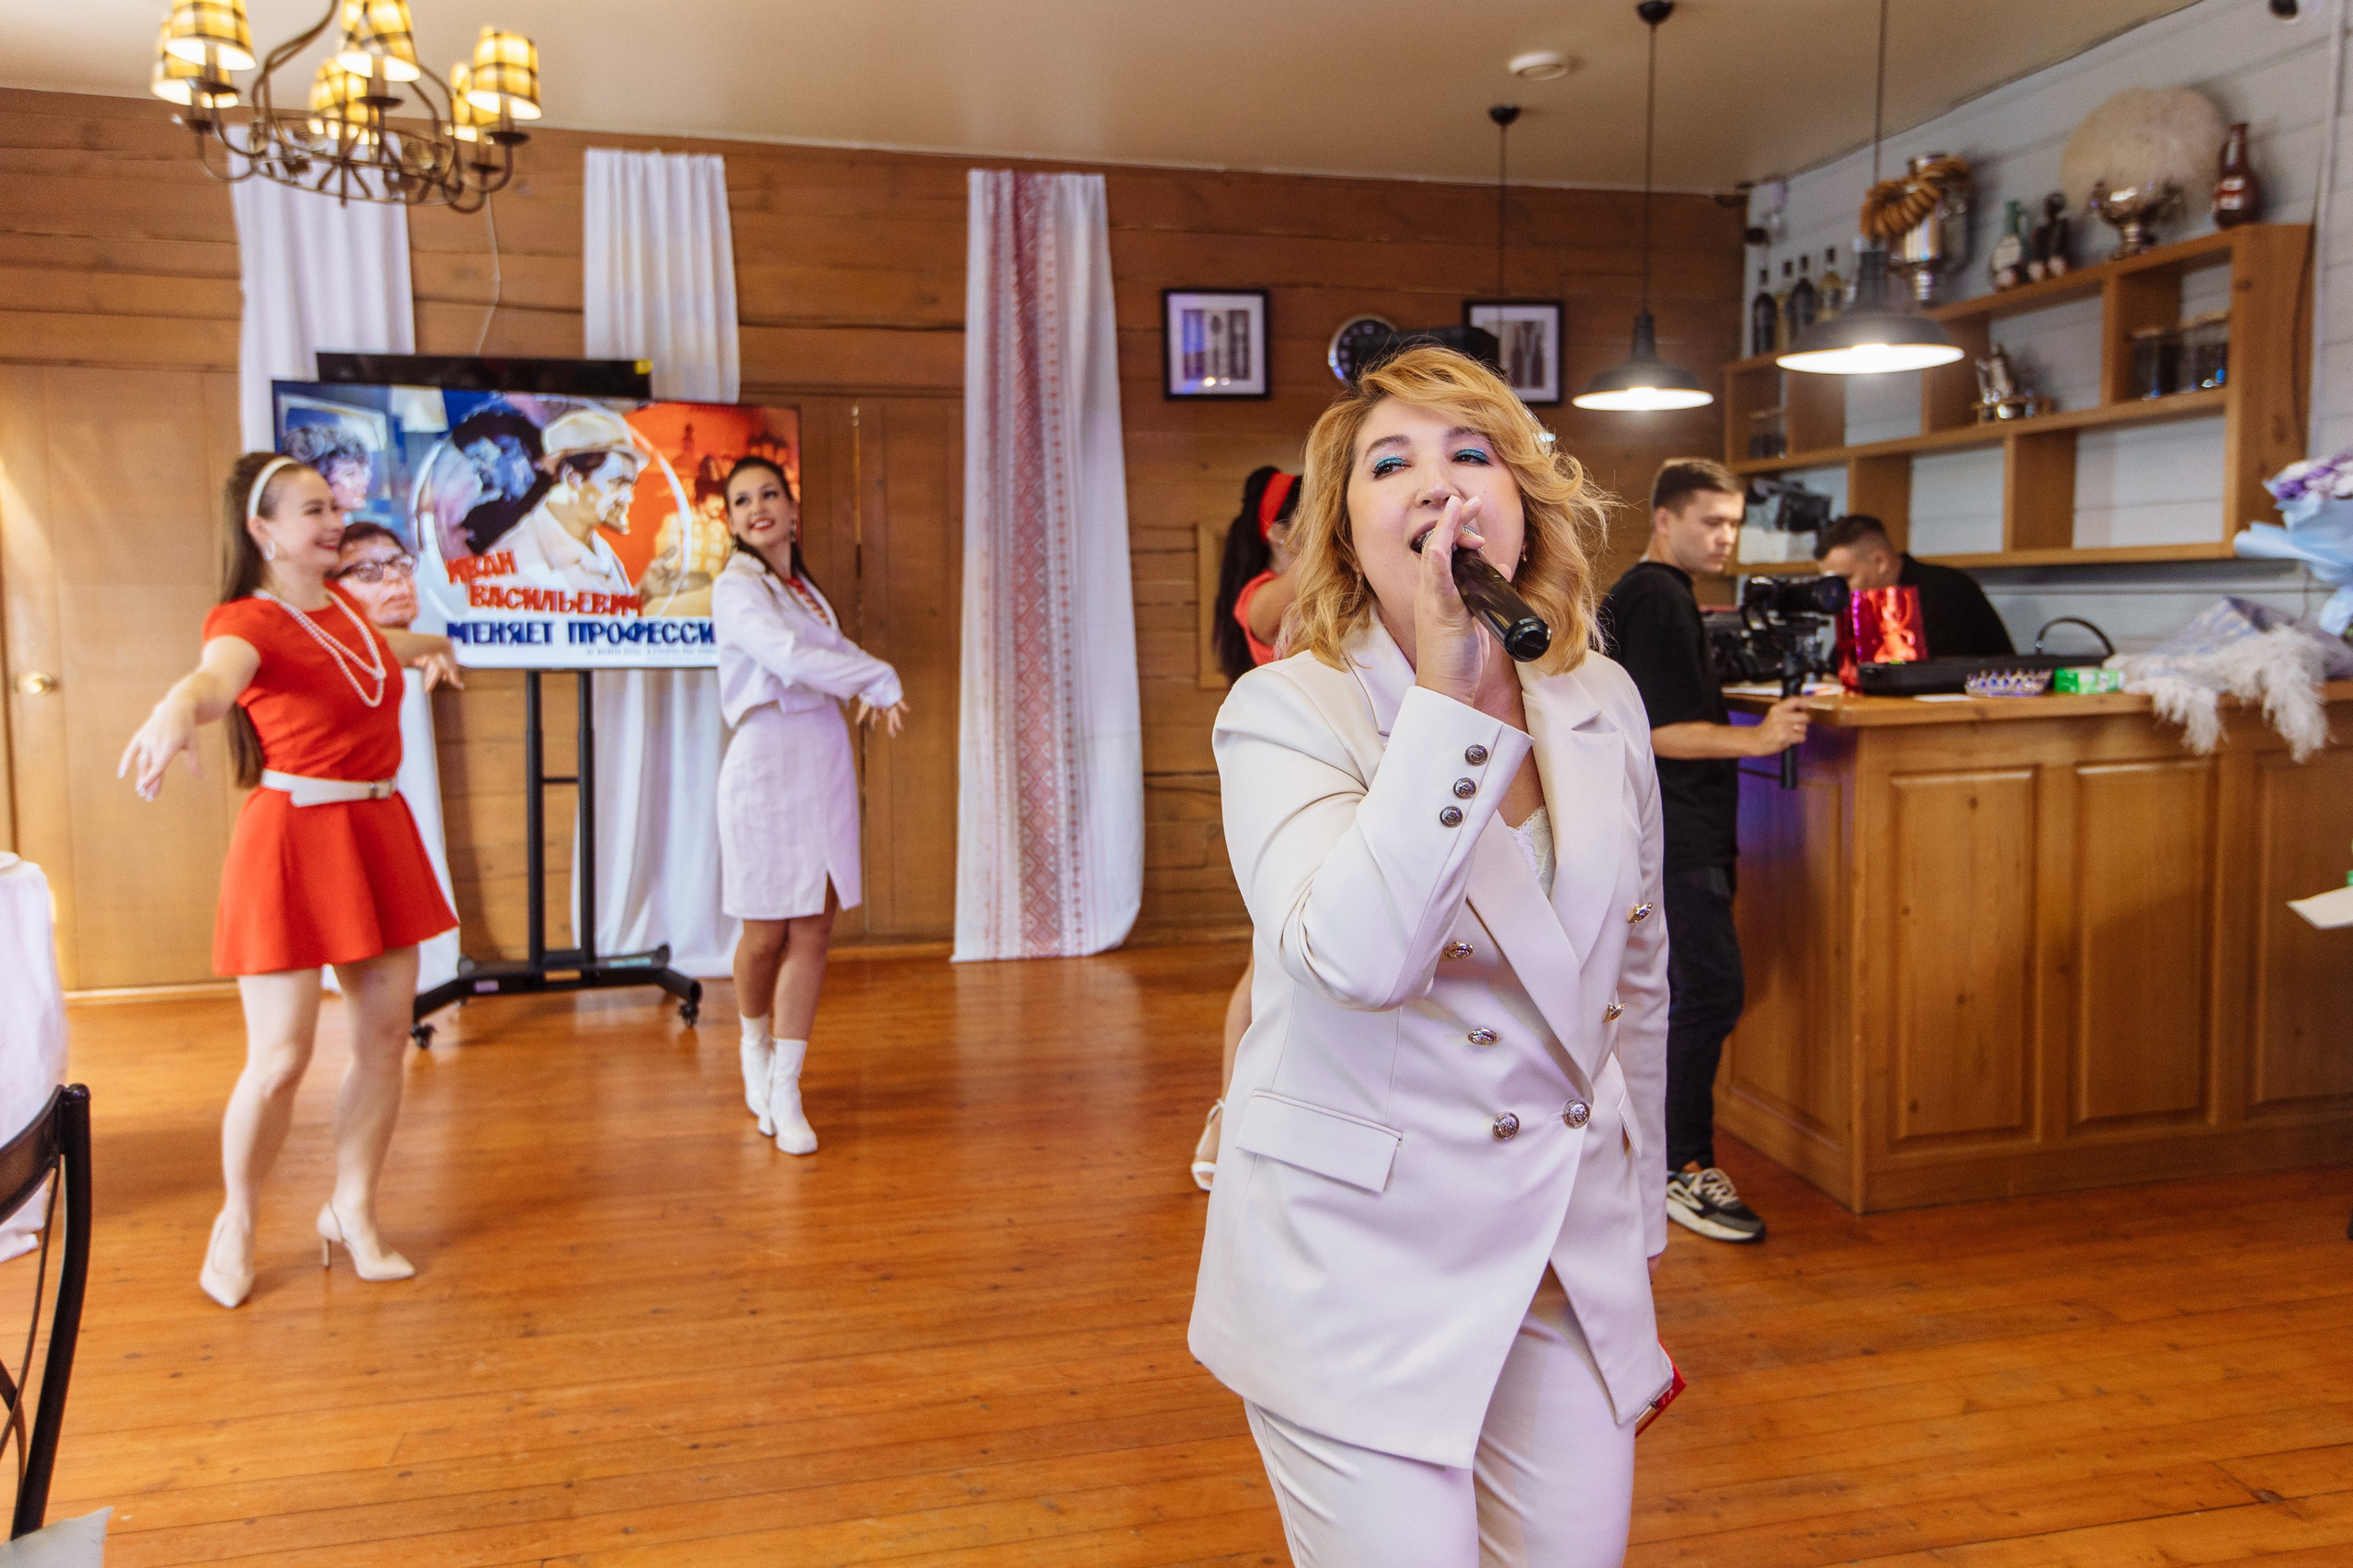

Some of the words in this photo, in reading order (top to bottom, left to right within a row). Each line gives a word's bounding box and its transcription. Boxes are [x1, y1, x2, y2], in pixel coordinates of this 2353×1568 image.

[446, 551, 517, 585] ИВАН
[469, 585, 642, 617] ВАСИЛЬЕВИЧ
[446, 620, 553, 644] МЕНЯЕТ
